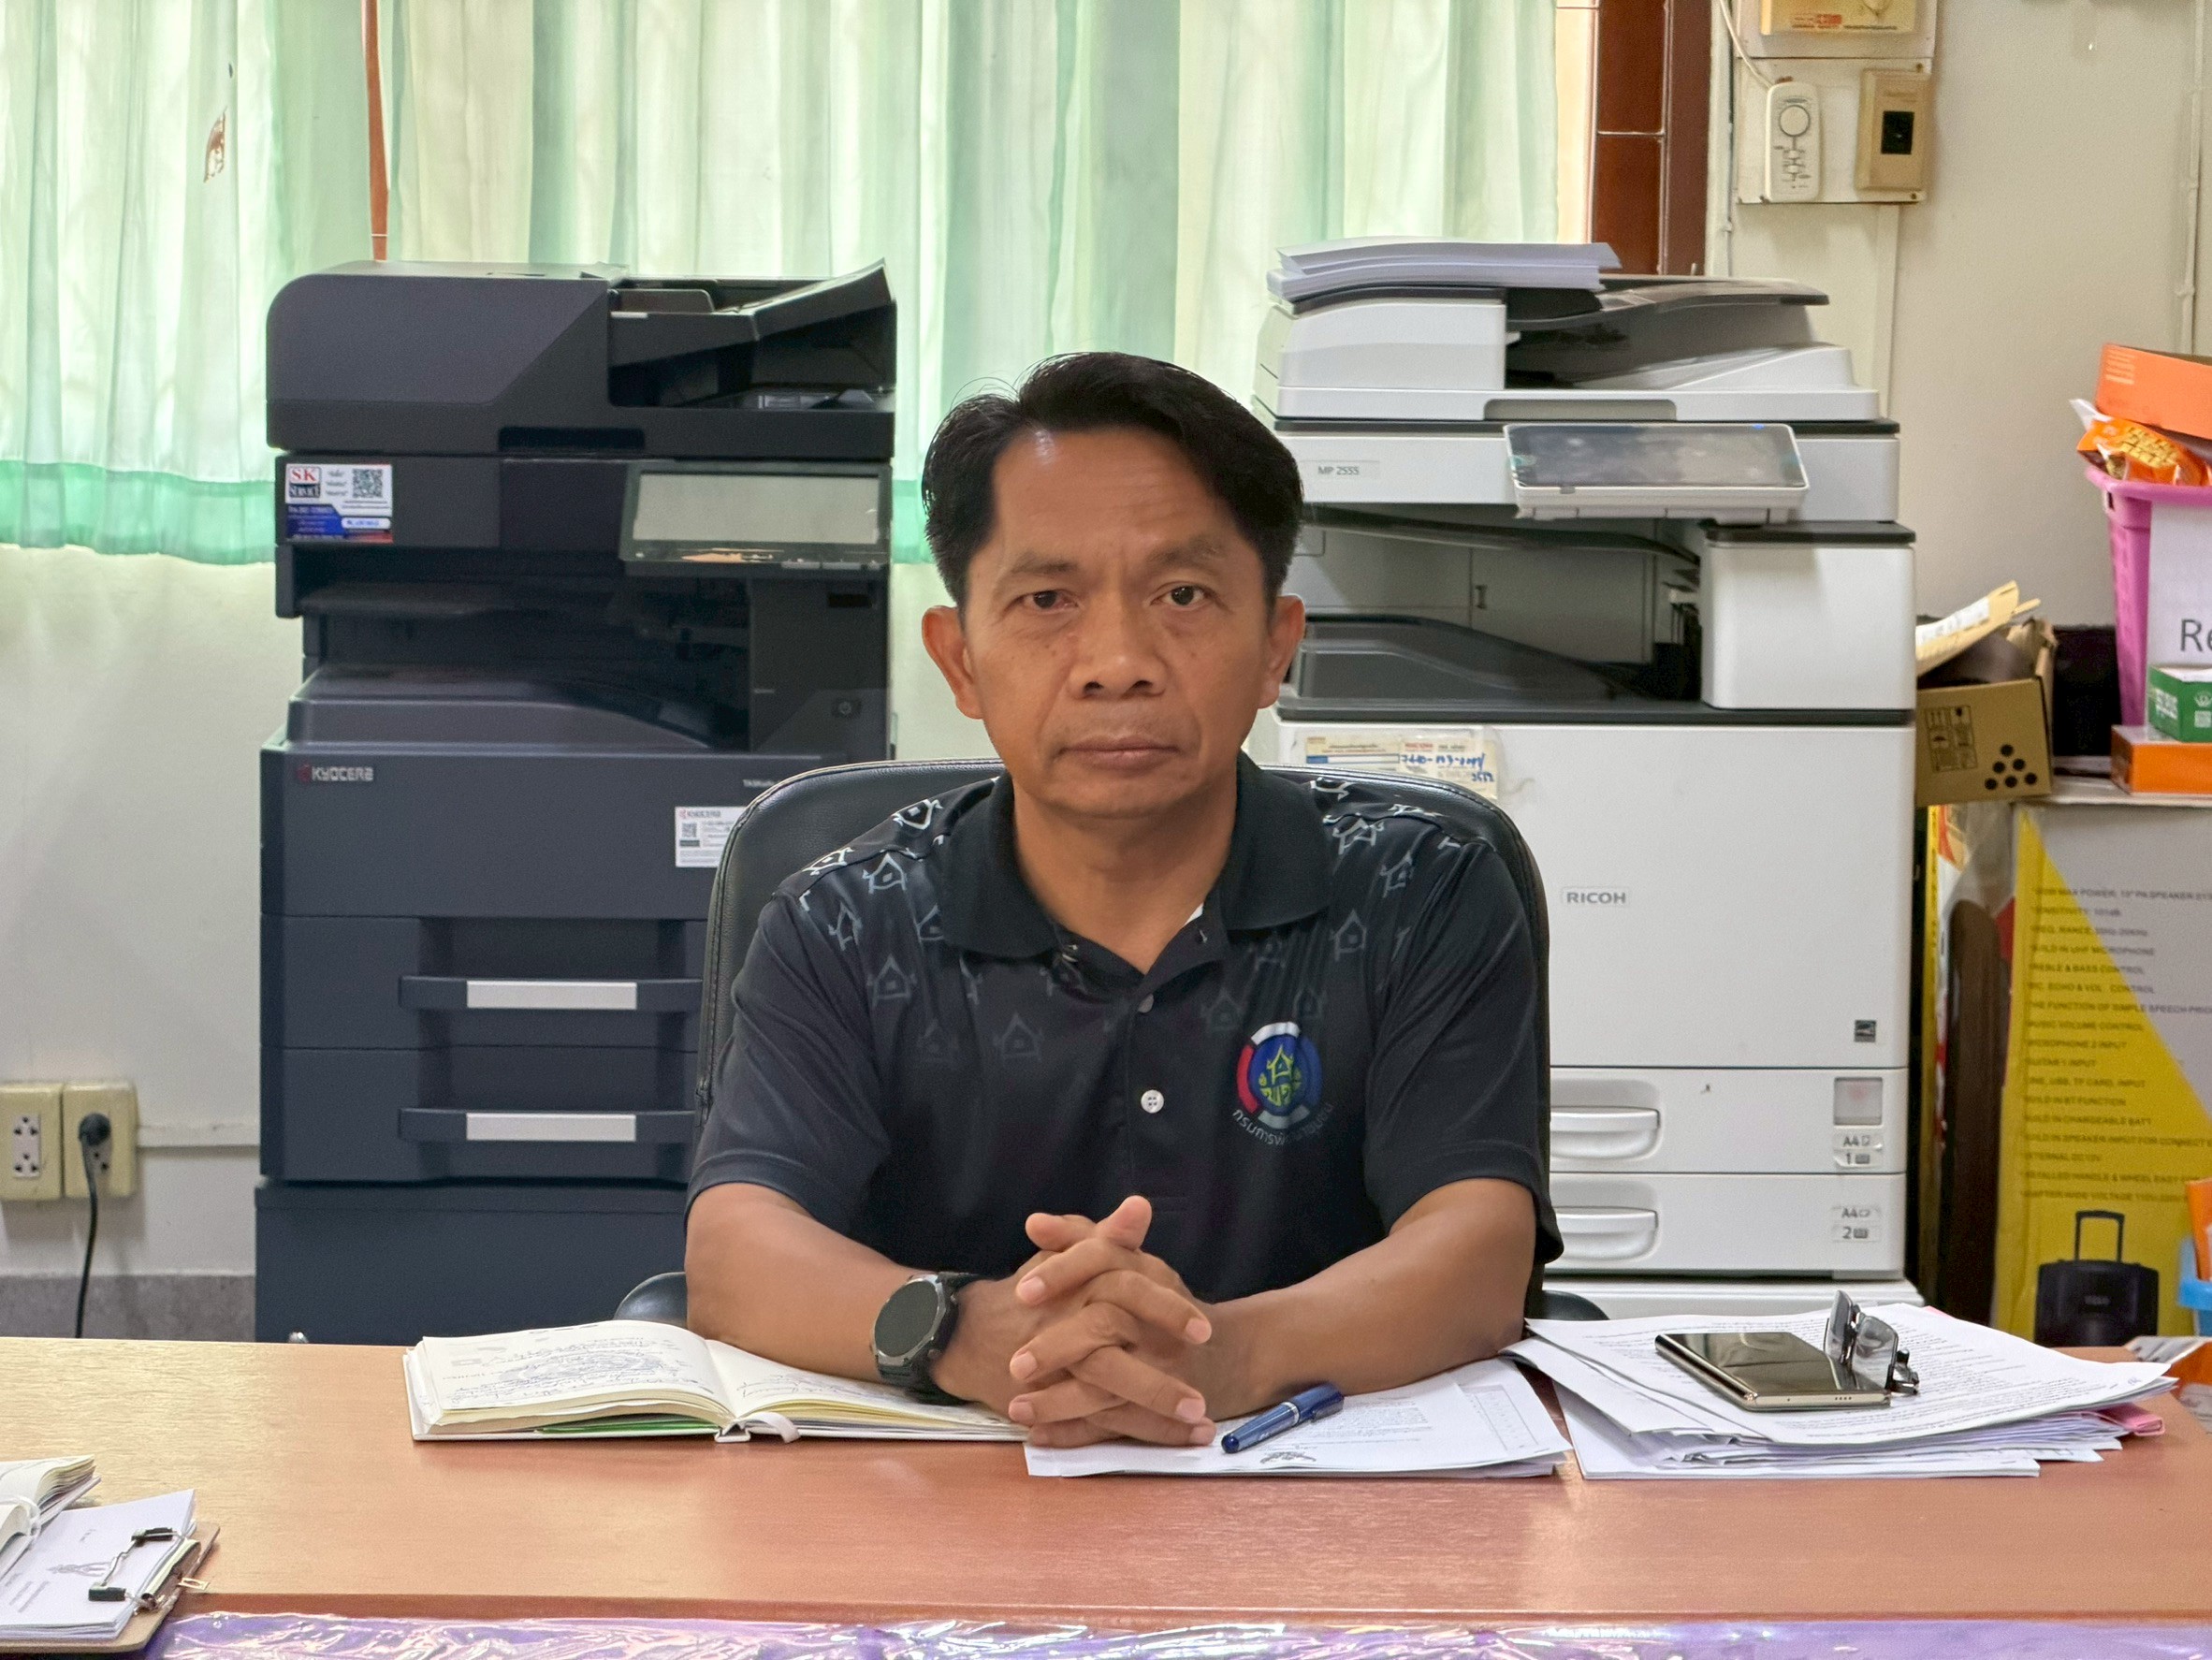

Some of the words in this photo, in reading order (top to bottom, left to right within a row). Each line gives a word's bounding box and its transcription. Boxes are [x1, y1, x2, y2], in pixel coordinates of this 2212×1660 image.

[291, 469, 316, 482] SK
[2180, 618, 2212, 652] R
[312, 766, 374, 782] KYOCERA
[1566, 892, 1626, 904] RICOH
[1842, 1135, 1859, 1146] A4
[1841, 1207, 1857, 1218] A4
[1841, 1227, 1852, 1239] 2
